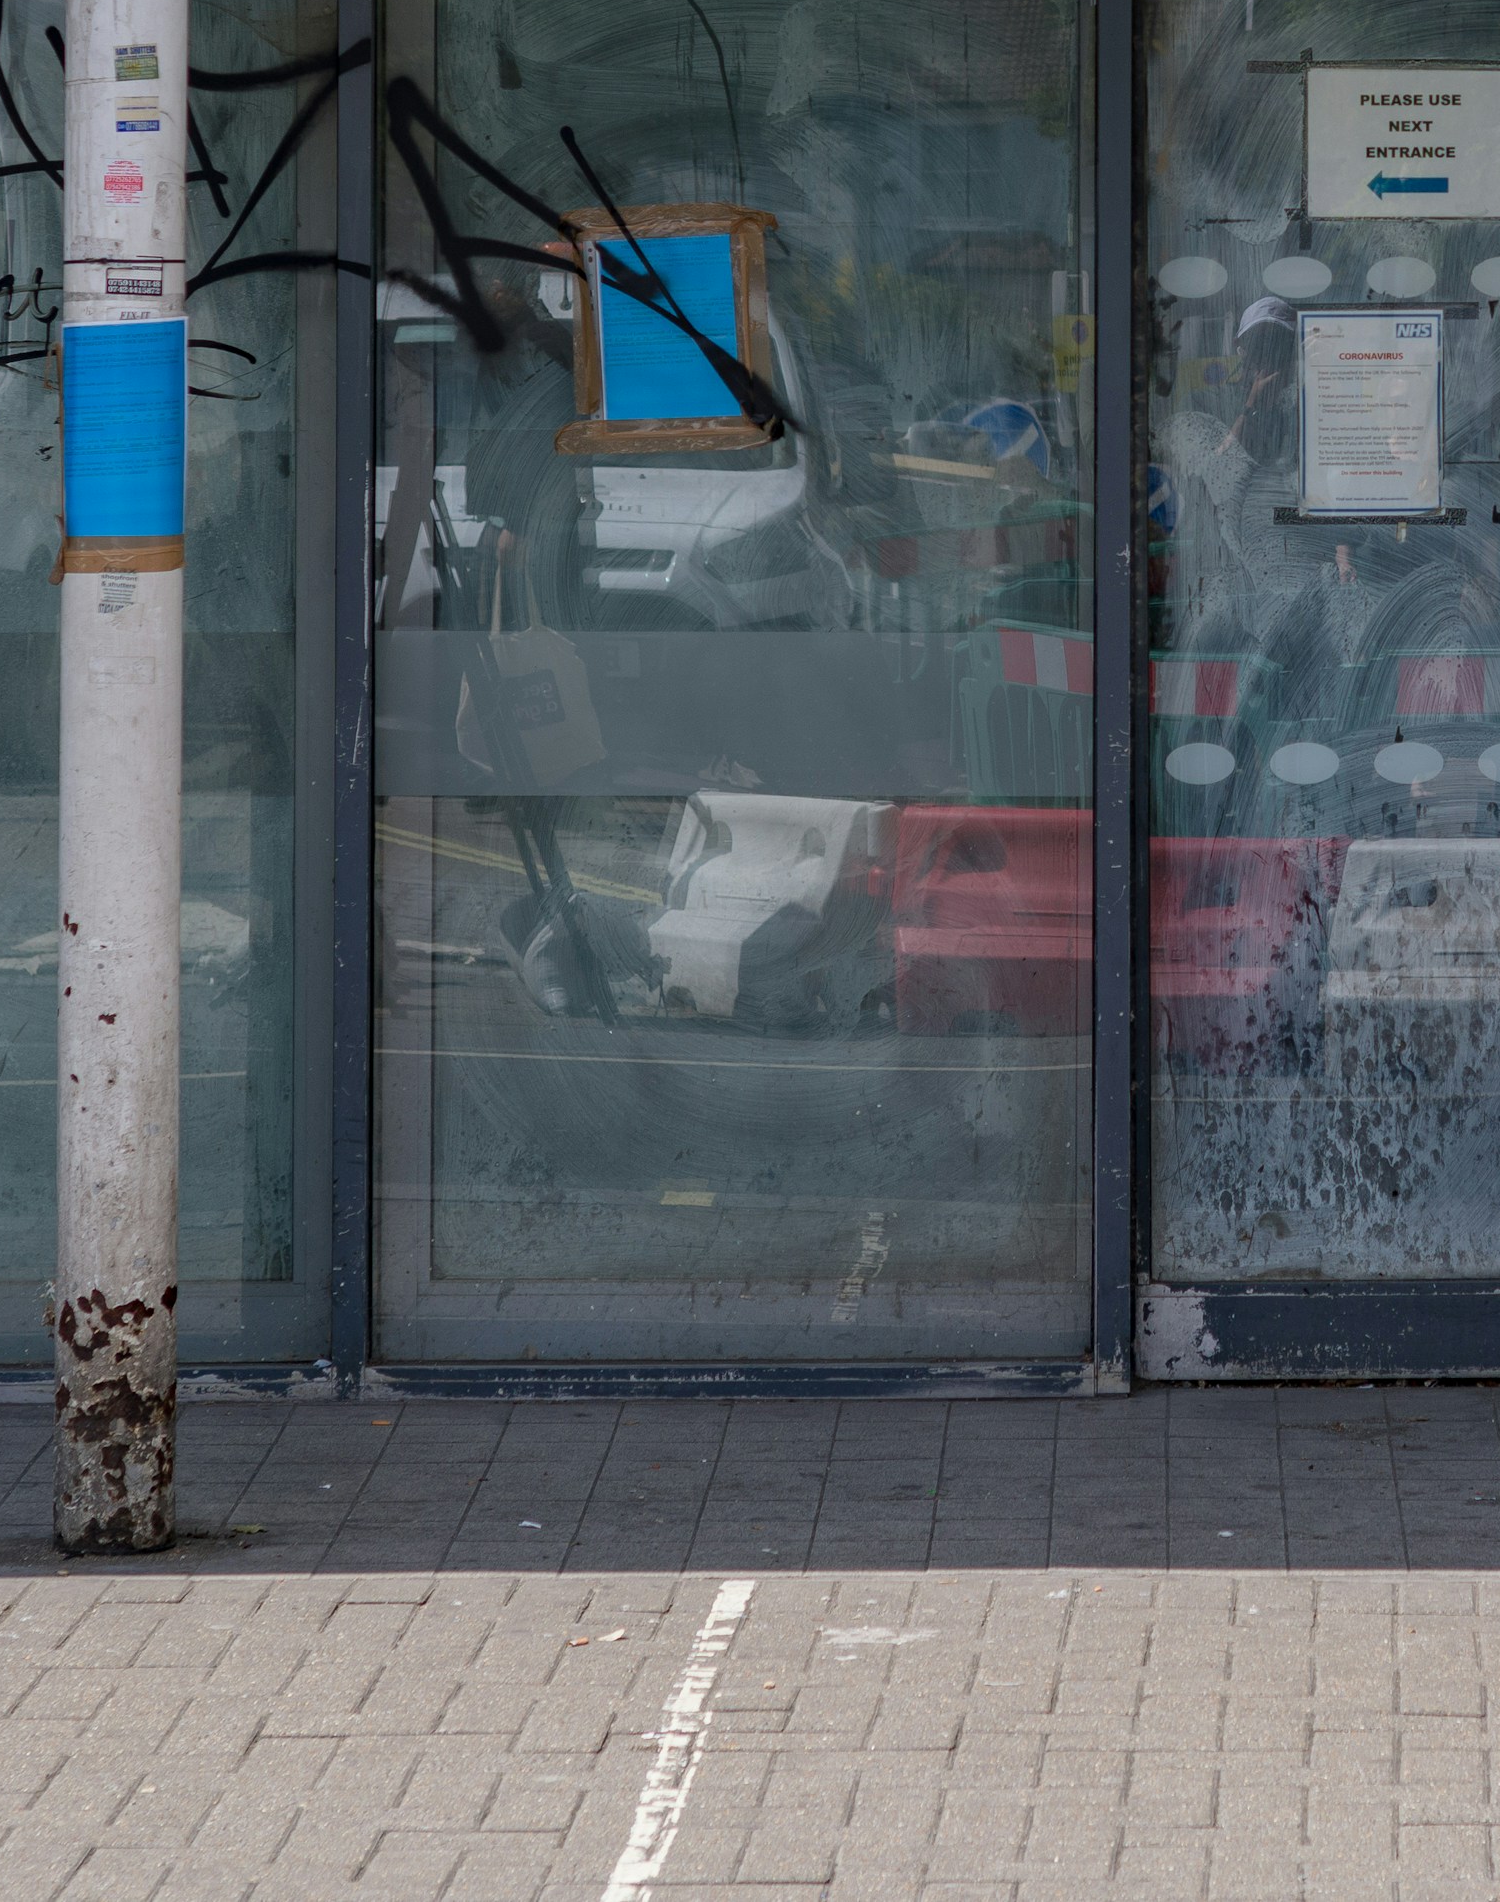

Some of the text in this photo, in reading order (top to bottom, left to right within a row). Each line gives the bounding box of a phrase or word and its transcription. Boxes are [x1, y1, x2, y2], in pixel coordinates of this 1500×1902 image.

[1360, 94, 1462, 107] PLEASE USE
[1388, 120, 1434, 133] NEXT
[1366, 145, 1457, 159] ENTRANCE
[120, 311, 151, 320] FIX-IT
[1397, 324, 1432, 338] NHS
[1339, 352, 1404, 361] CORONAVIRUS
